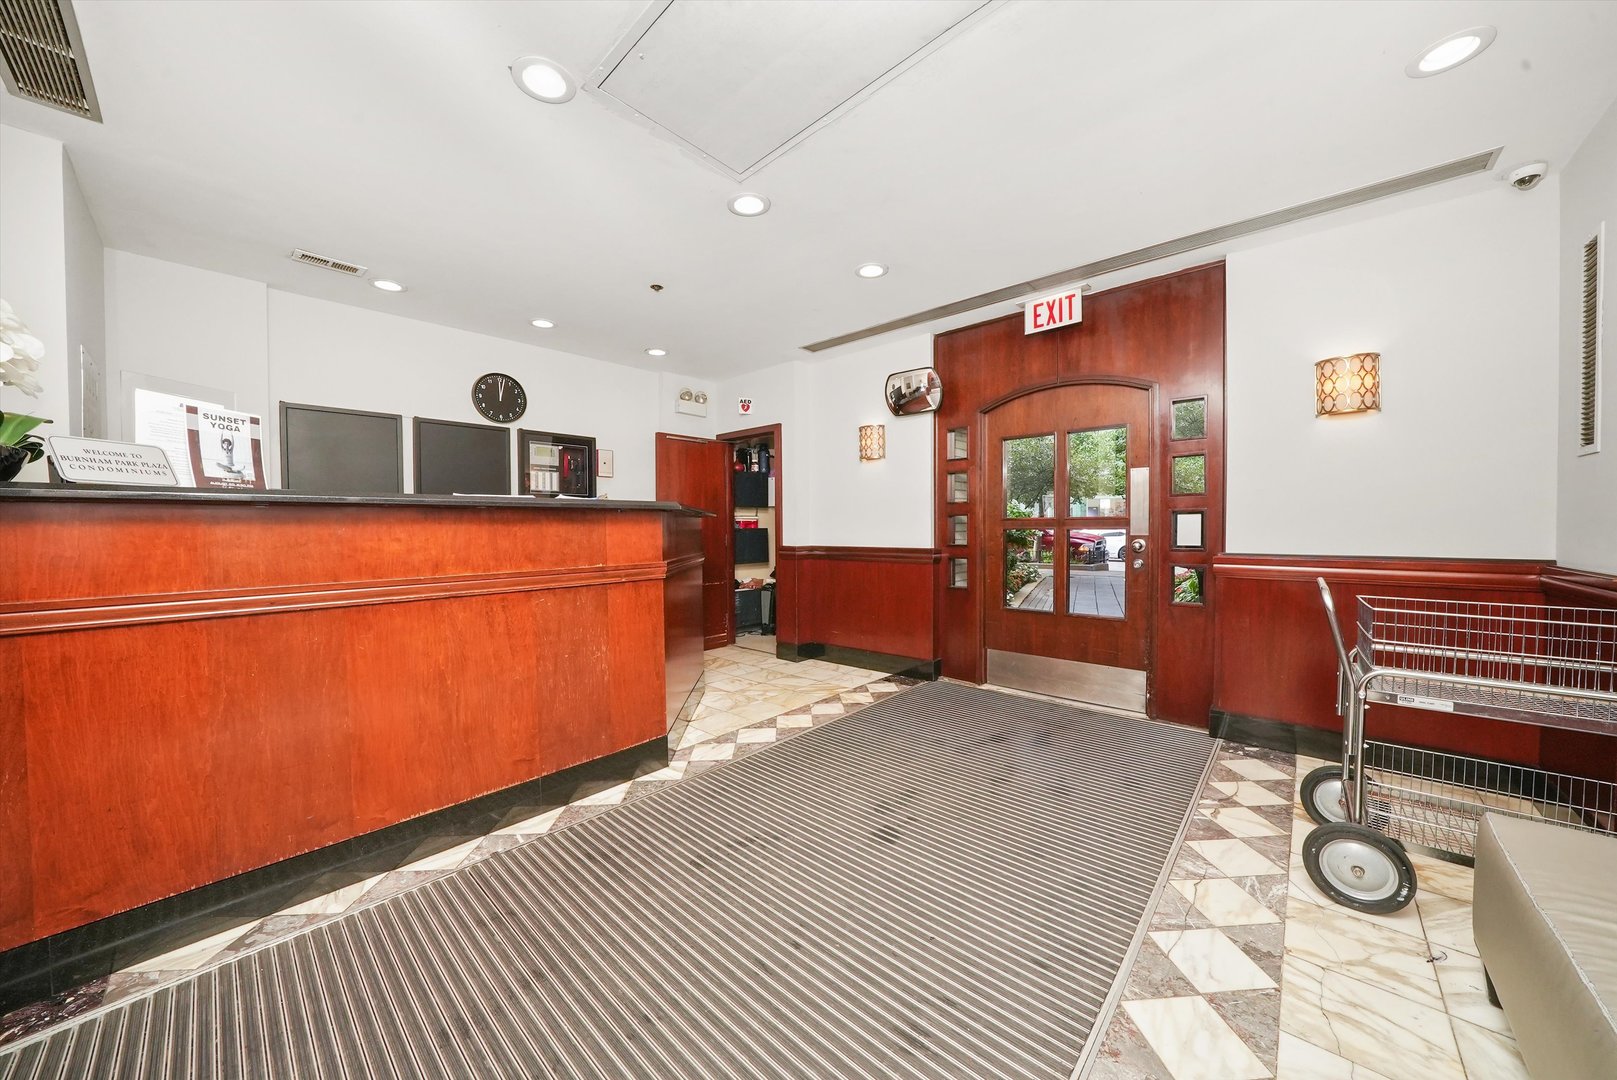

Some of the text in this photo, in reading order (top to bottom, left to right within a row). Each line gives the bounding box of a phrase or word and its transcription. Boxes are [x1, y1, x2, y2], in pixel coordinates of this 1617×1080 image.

[1033, 293, 1076, 329] EXIT
[202, 412, 247, 426] SUNSET
[210, 421, 241, 433] YOGA
[82, 448, 129, 459] WELCOME
[60, 454, 168, 470] BURNHAM PARK PLAZA
[69, 463, 168, 476] CONDOMINIUMS
